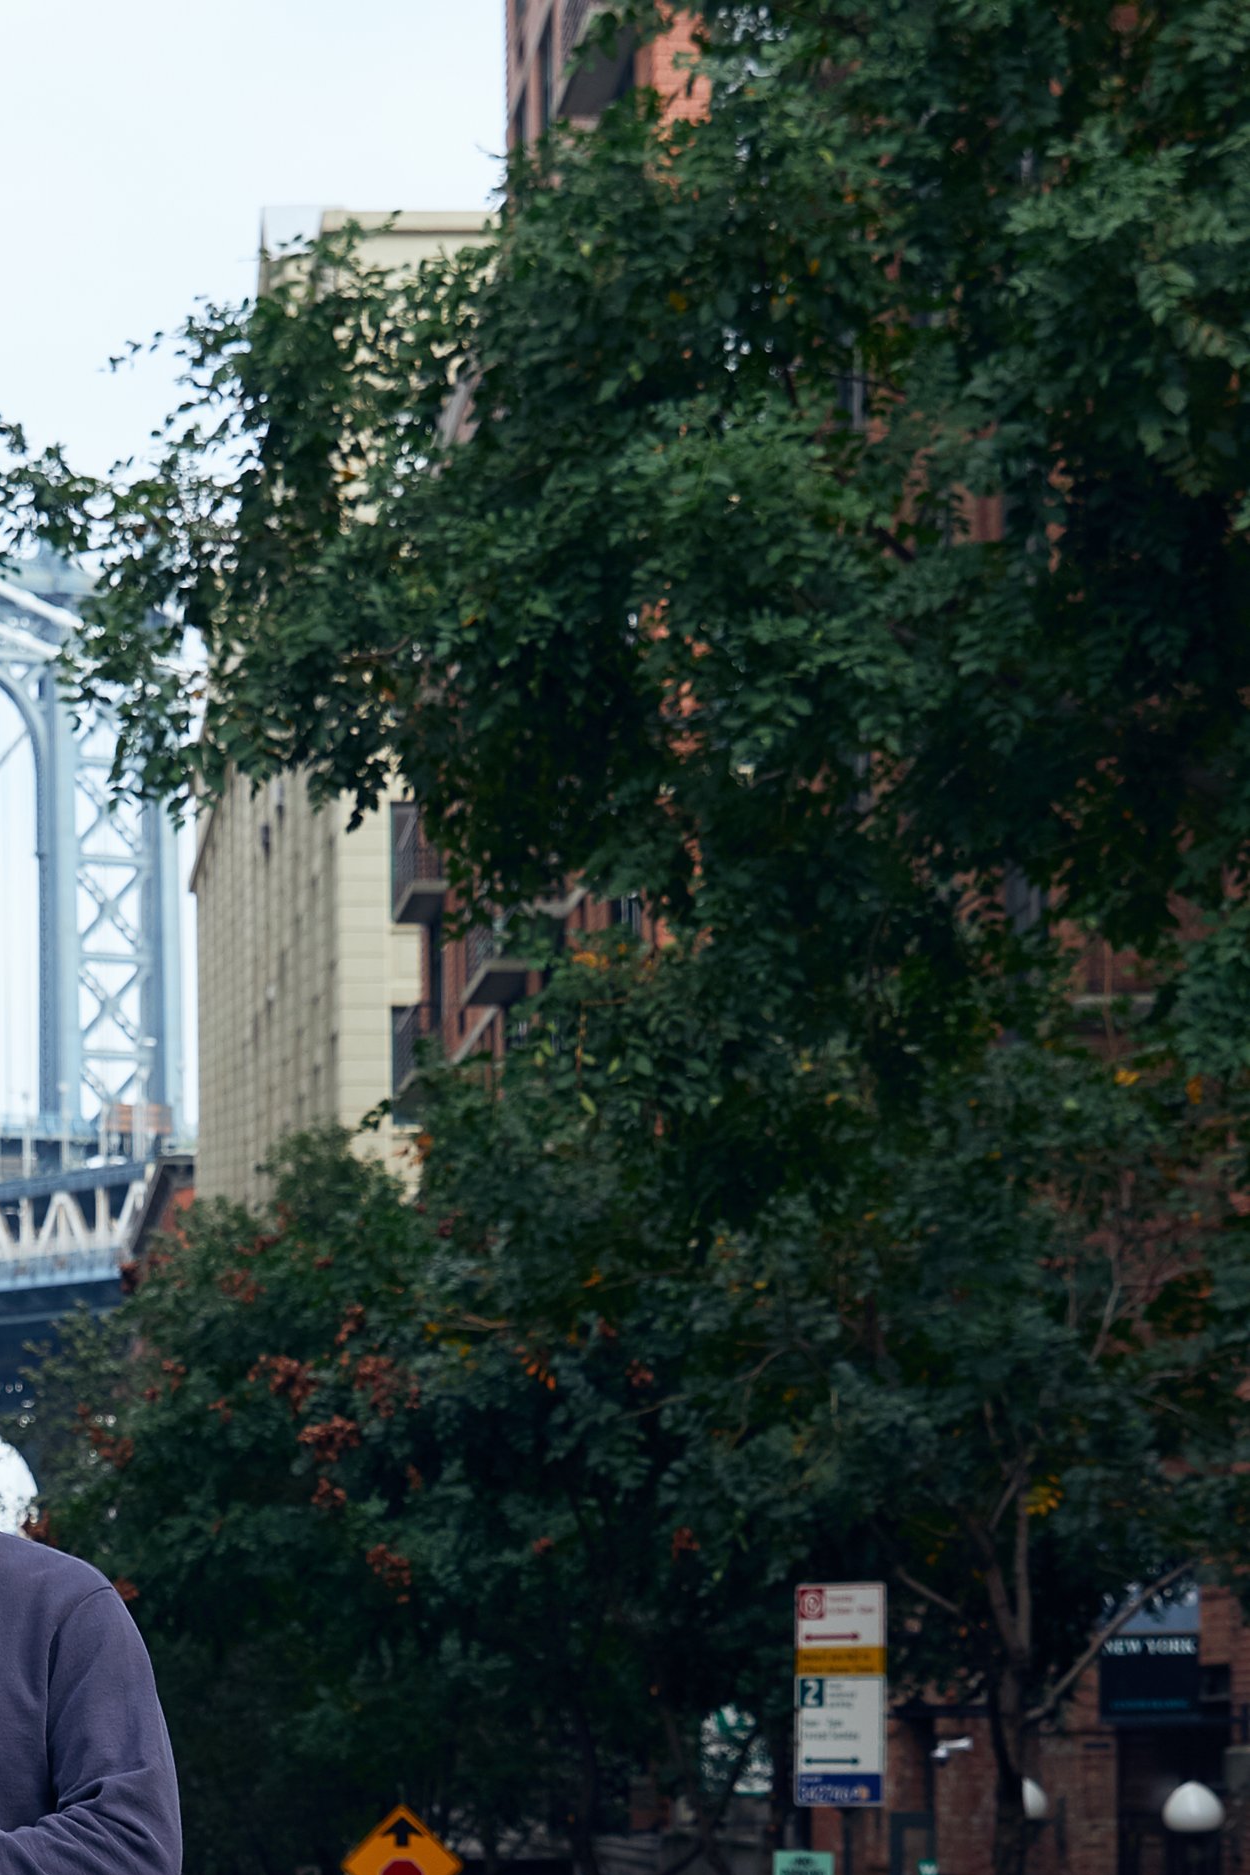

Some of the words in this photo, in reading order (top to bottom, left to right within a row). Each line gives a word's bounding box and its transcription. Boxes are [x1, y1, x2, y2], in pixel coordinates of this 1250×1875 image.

[1102, 1638, 1141, 1656] NEW
[1144, 1637, 1197, 1656] YORK
[803, 1680, 820, 1706] 2
